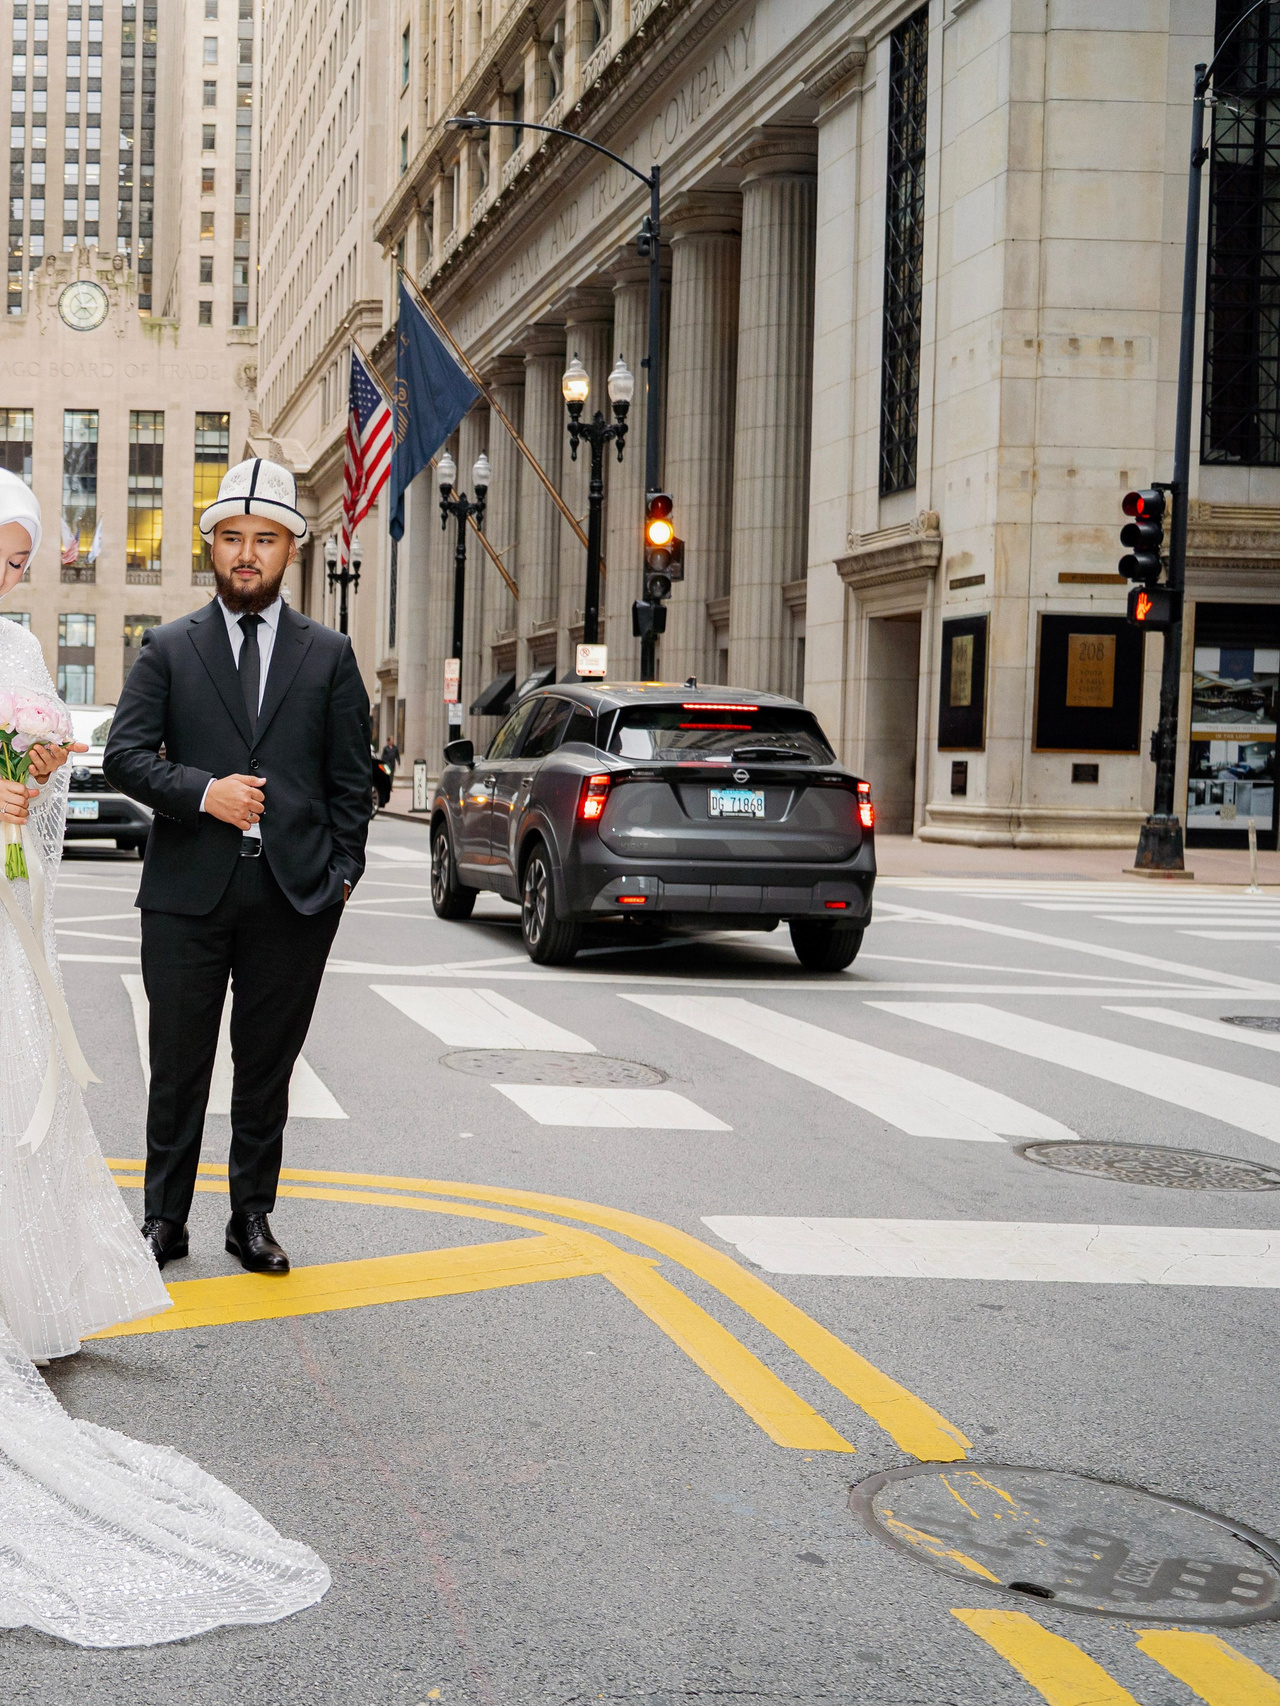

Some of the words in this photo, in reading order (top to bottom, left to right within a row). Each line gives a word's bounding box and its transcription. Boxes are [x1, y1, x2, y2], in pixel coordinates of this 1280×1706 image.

[510, 235, 542, 298] BANK
[550, 201, 579, 260] AND
[589, 136, 639, 219] TRUST
[649, 17, 755, 159] COMPANY
[49, 362, 115, 379] BOARD
[124, 363, 151, 378] OF
[158, 363, 222, 380] TRADE
[1079, 642, 1105, 661] 208
[712, 796, 724, 811] DG
[730, 797, 763, 812] 71868
